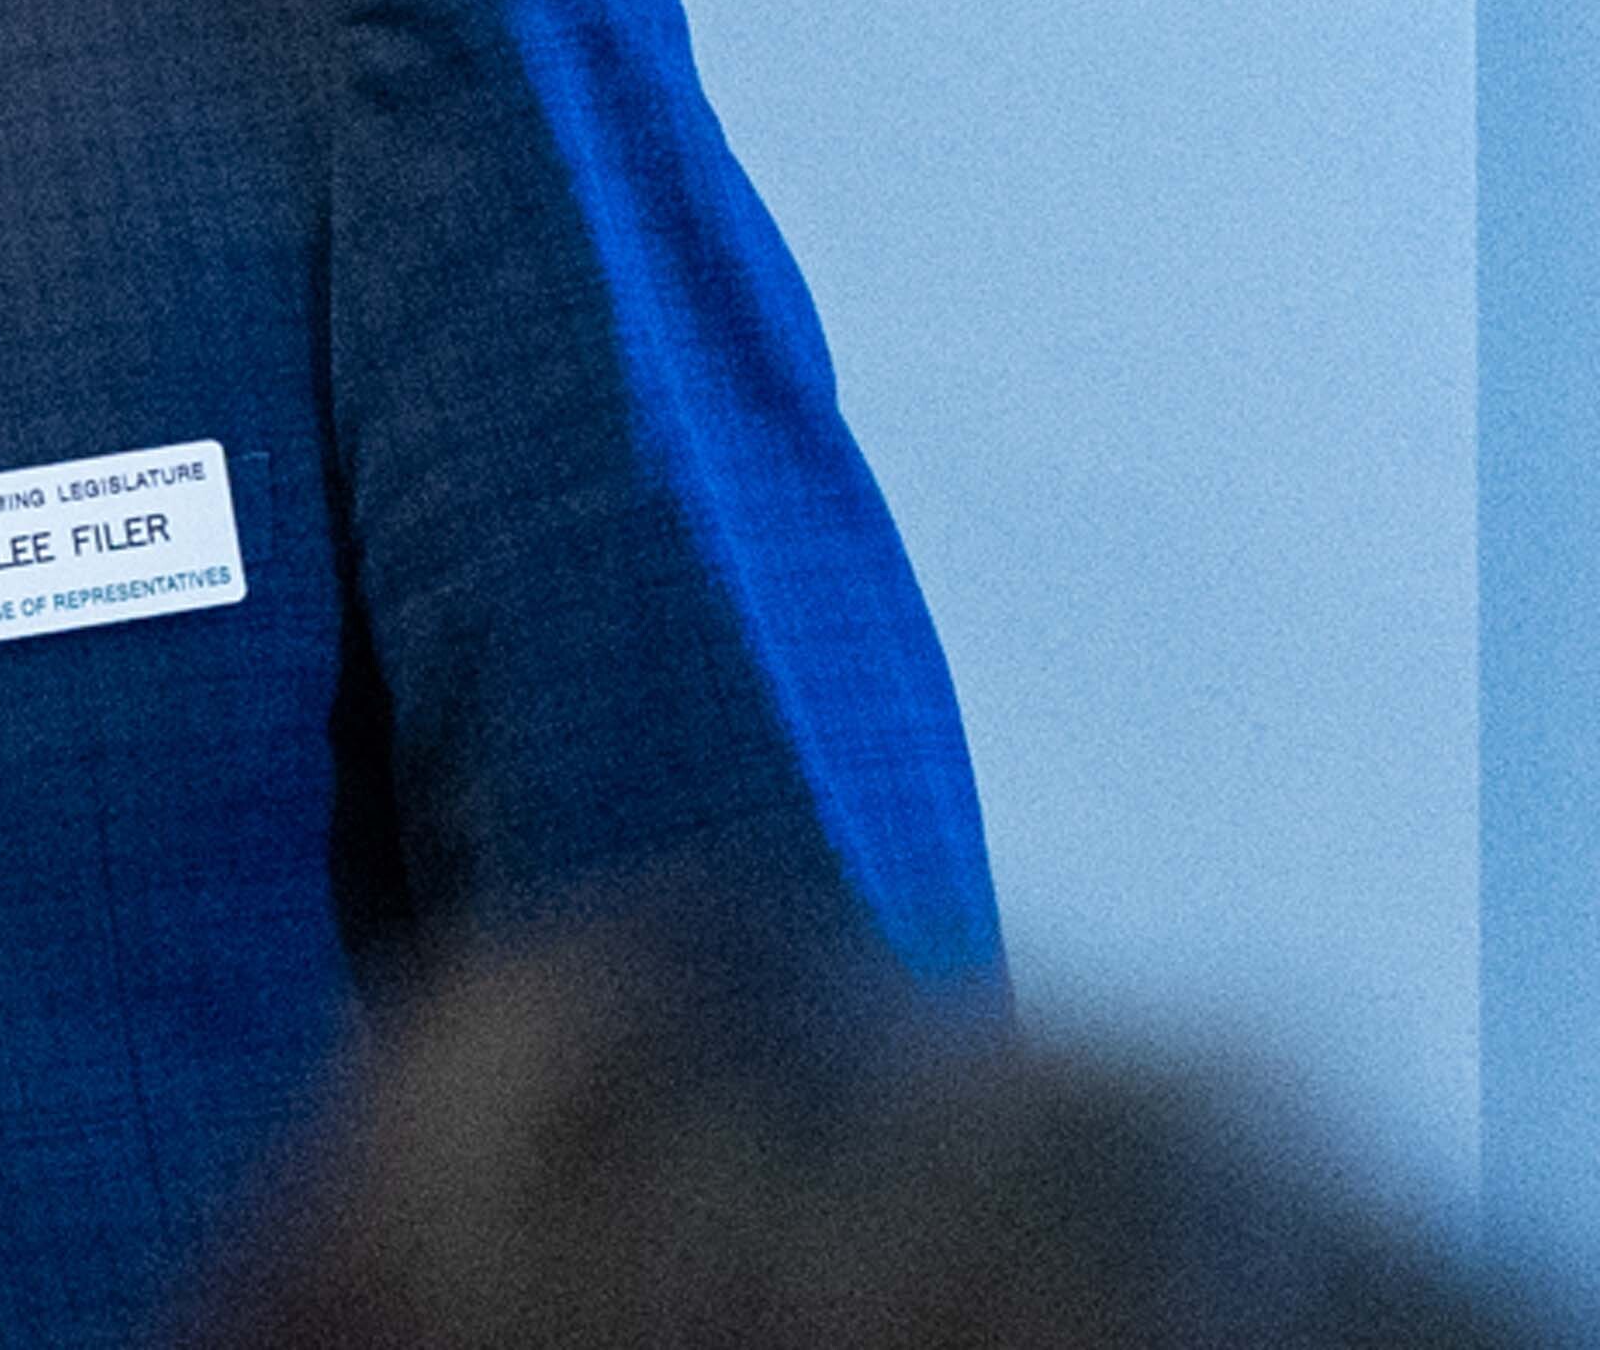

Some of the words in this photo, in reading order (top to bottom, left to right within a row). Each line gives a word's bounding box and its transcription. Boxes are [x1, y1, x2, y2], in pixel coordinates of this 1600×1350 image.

[57, 461, 206, 503] LEGISLATURE
[70, 513, 171, 557] FILER
[21, 597, 47, 617] OF
[53, 565, 232, 612] REPRESENTATIVES
